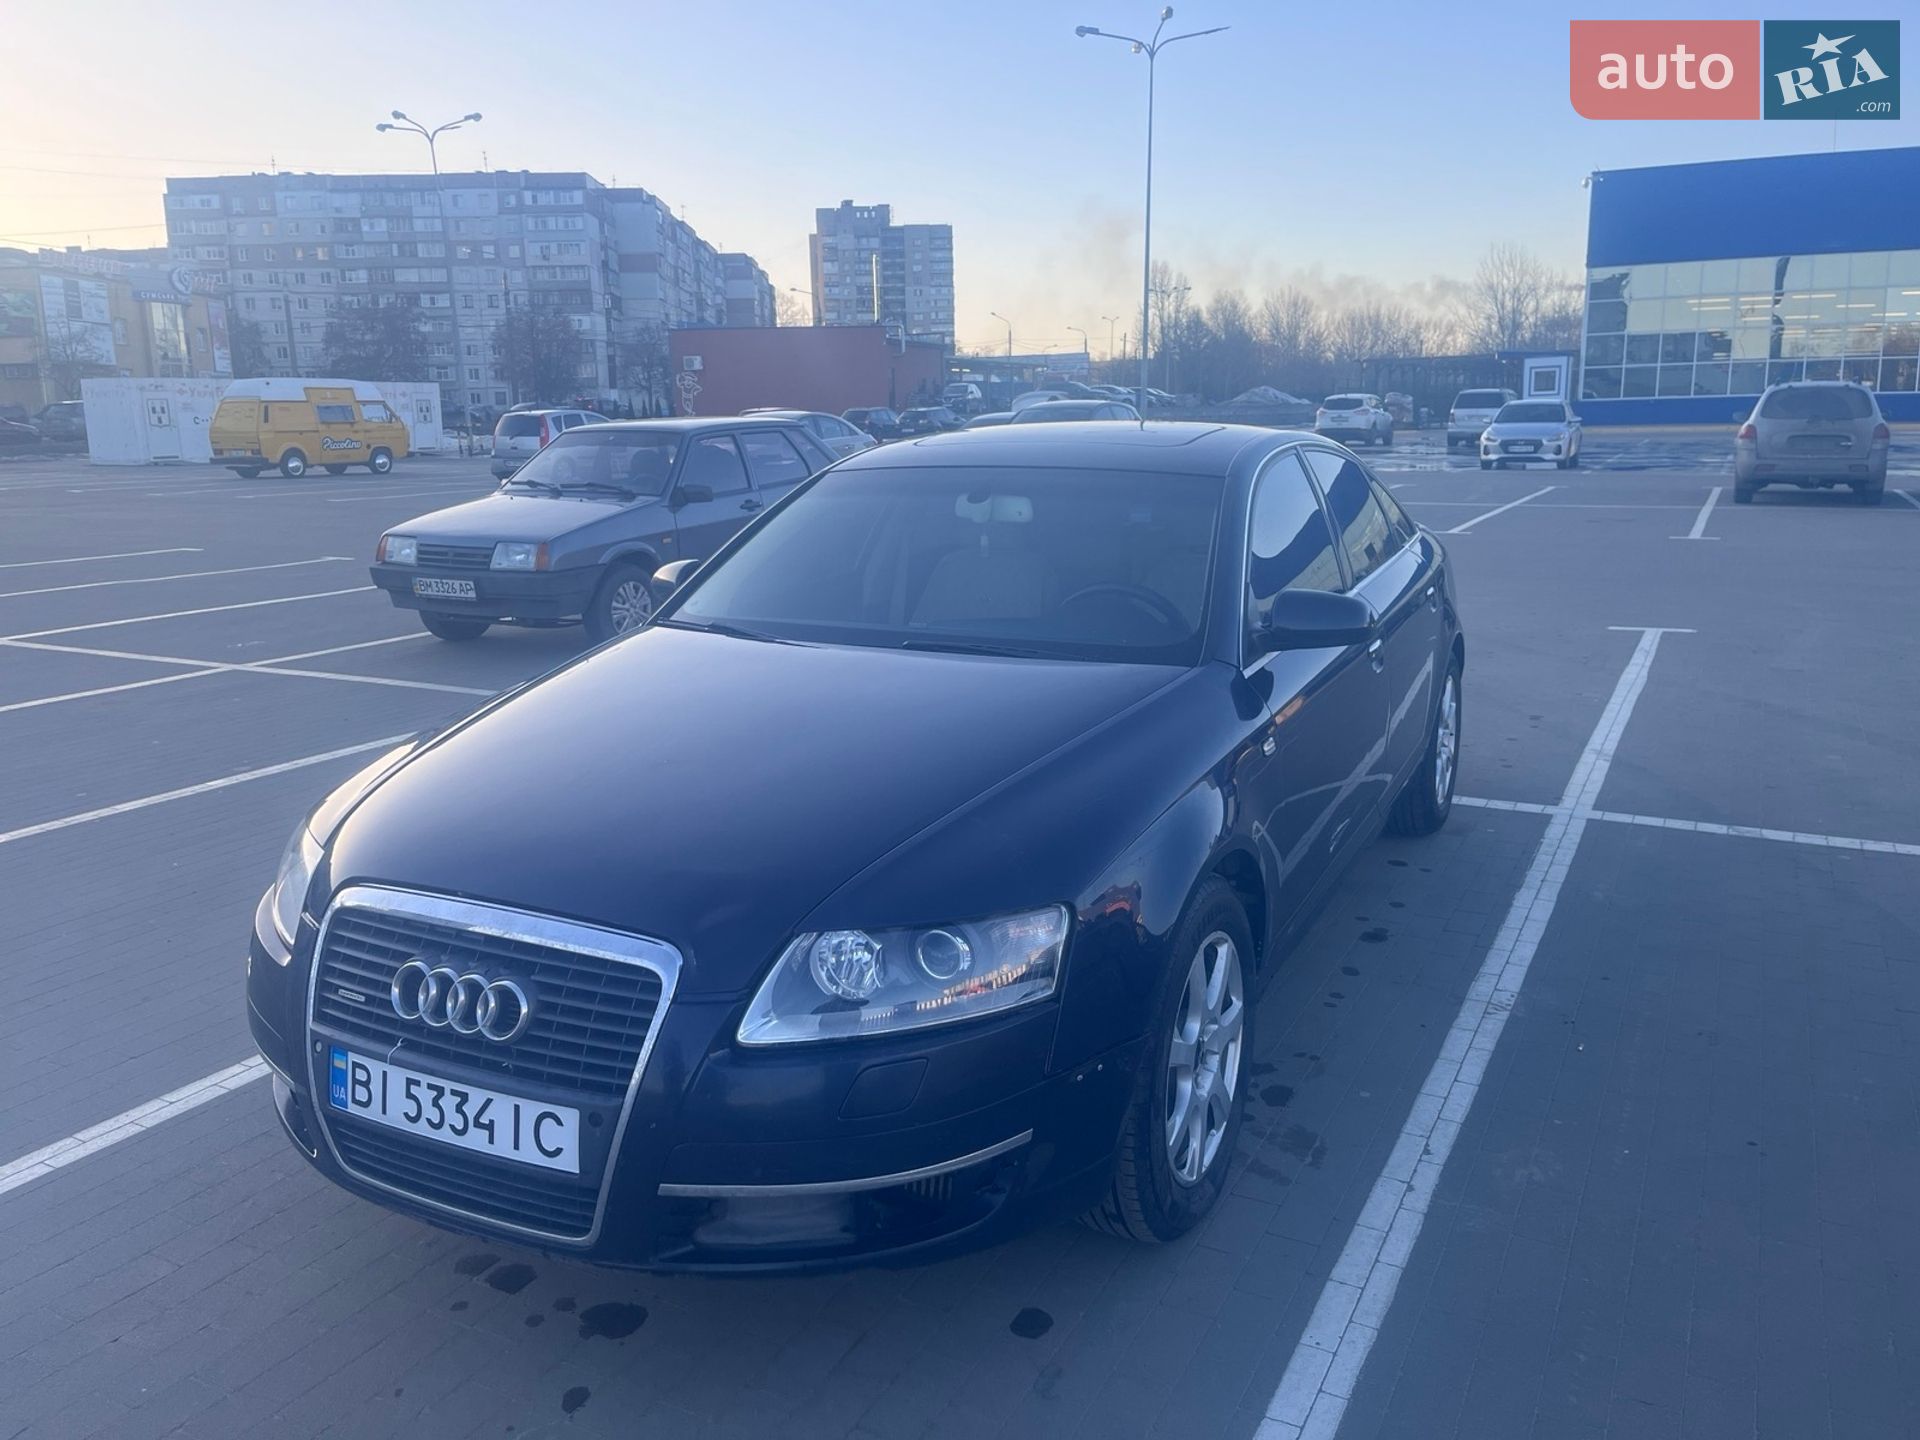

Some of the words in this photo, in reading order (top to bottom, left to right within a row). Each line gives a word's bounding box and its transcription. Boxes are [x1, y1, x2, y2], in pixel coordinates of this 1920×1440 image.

[418, 579, 433, 593] BM
[434, 581, 457, 594] 3326
[332, 1083, 346, 1101] UA
[351, 1060, 388, 1115] BI
[403, 1077, 495, 1145] 5334
[513, 1103, 565, 1159] IC
